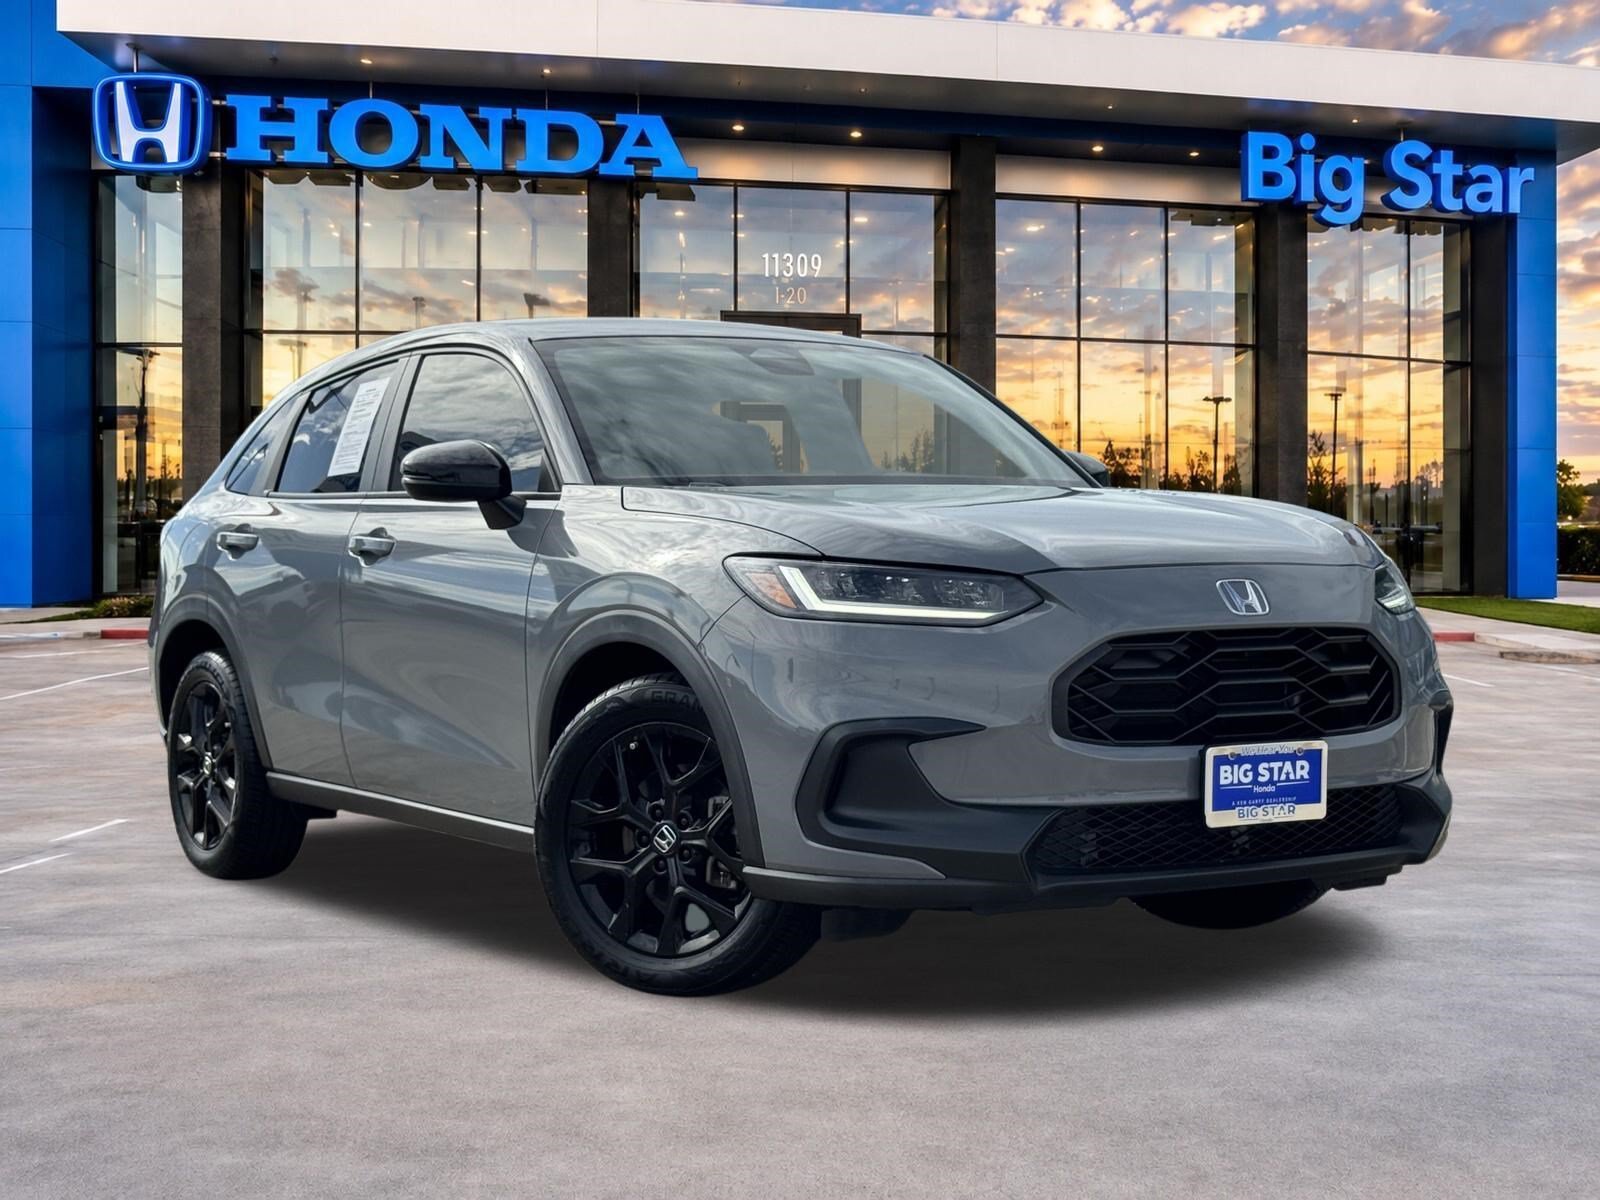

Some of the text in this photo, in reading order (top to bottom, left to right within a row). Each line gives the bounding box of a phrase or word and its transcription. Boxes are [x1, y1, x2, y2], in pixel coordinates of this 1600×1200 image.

[225, 94, 698, 180] HONDA
[1240, 131, 1535, 226] Big Star
[761, 252, 822, 278] 11309
[1219, 760, 1311, 785] BIG STAR
[1253, 783, 1276, 793] Honda
[1237, 804, 1296, 819] BIG STAR
